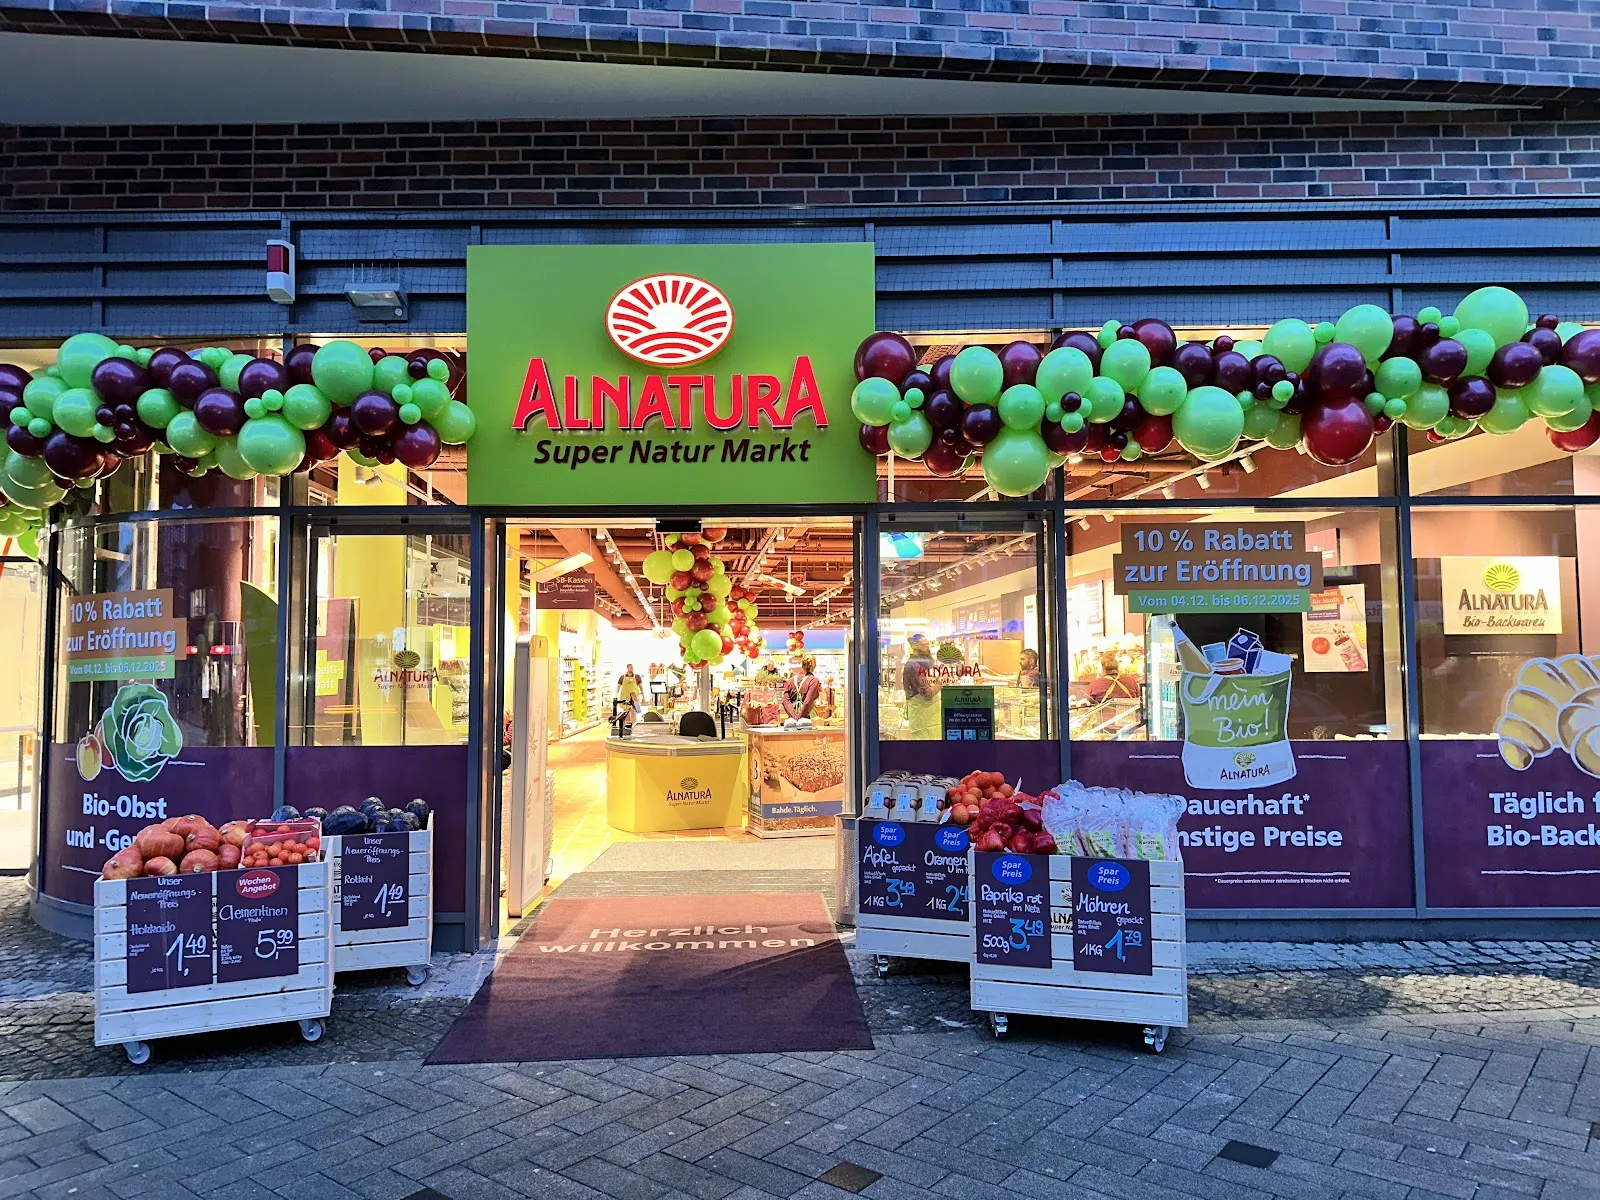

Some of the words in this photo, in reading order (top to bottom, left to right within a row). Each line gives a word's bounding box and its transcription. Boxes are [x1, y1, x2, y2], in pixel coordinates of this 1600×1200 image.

[512, 356, 829, 431] ALNATURA
[534, 439, 622, 469] Super
[629, 439, 714, 463] Natur
[721, 437, 811, 462] Markt
[1133, 530, 1163, 552] 10
[1169, 529, 1194, 551] %
[1204, 528, 1293, 551] Rabatt
[1125, 564, 1168, 582] zur
[1176, 557, 1311, 587] Eröffnung
[555, 576, 593, 584] SB-Kassen
[1138, 596, 1167, 607] Vom
[1171, 596, 1208, 606] 04.12.
[1212, 595, 1230, 606] bis
[1234, 594, 1301, 606] 06.12.2025
[1458, 588, 1549, 611] ALNATURA
[70, 602, 83, 623] 10
[85, 600, 97, 622] %
[103, 597, 163, 620] Rabatt
[1462, 615, 1545, 628] Bio-Backwaren
[66, 634, 84, 652] zur
[87, 626, 176, 653] Eröffnung
[69, 665, 82, 675] Vom
[83, 664, 104, 674] 04.12.
[105, 663, 117, 673] bis
[118, 661, 166, 673] 06.12.2025
[373, 667, 440, 682] ALNATURA
[917, 662, 982, 678] ALNATURA
[1212, 708, 1269, 743] Bio!
[1220, 764, 1271, 780] ALNATURA
[666, 787, 712, 801] ALNATURA
[82, 793, 168, 819] Bio-Obst
[1488, 791, 1585, 820] Täglich
[880, 826, 897, 834] Spar
[943, 831, 960, 839] Spar
[1264, 825, 1343, 847] Preise
[66, 826, 95, 849] und
[99, 829, 137, 852] -Ge
[363, 837, 384, 845] Unser
[344, 846, 404, 857] Neueröffnungs-
[364, 855, 381, 863] Preis
[863, 844, 899, 867] Äpfel
[891, 864, 917, 873] gepackt
[924, 850, 968, 874] Orangen
[1001, 860, 1022, 870] Spar
[1001, 870, 1023, 878] Preis
[1098, 866, 1120, 876] Spar
[157, 877, 183, 886] Unser
[239, 876, 271, 886] Wochen
[344, 874, 373, 884] Rotkohl
[1098, 876, 1120, 885] Preis
[130, 889, 202, 901] Neueröffnungs-
[241, 882, 277, 894] Angebot
[981, 884, 1024, 906] Paprika
[1026, 893, 1044, 905] rot
[157, 900, 179, 909] Preis
[945, 885, 969, 915] 2,4
[1012, 903, 1023, 912] im
[1076, 892, 1131, 915] Möhren
[219, 904, 288, 921] Clementinen
[129, 921, 176, 936] Hokkaido
[1115, 916, 1145, 926] gepackt
[588, 924, 769, 939] Herzlich
[255, 929, 296, 960] 5,99
[538, 937, 816, 953] willkommen
[983, 934, 1010, 954] 500g
